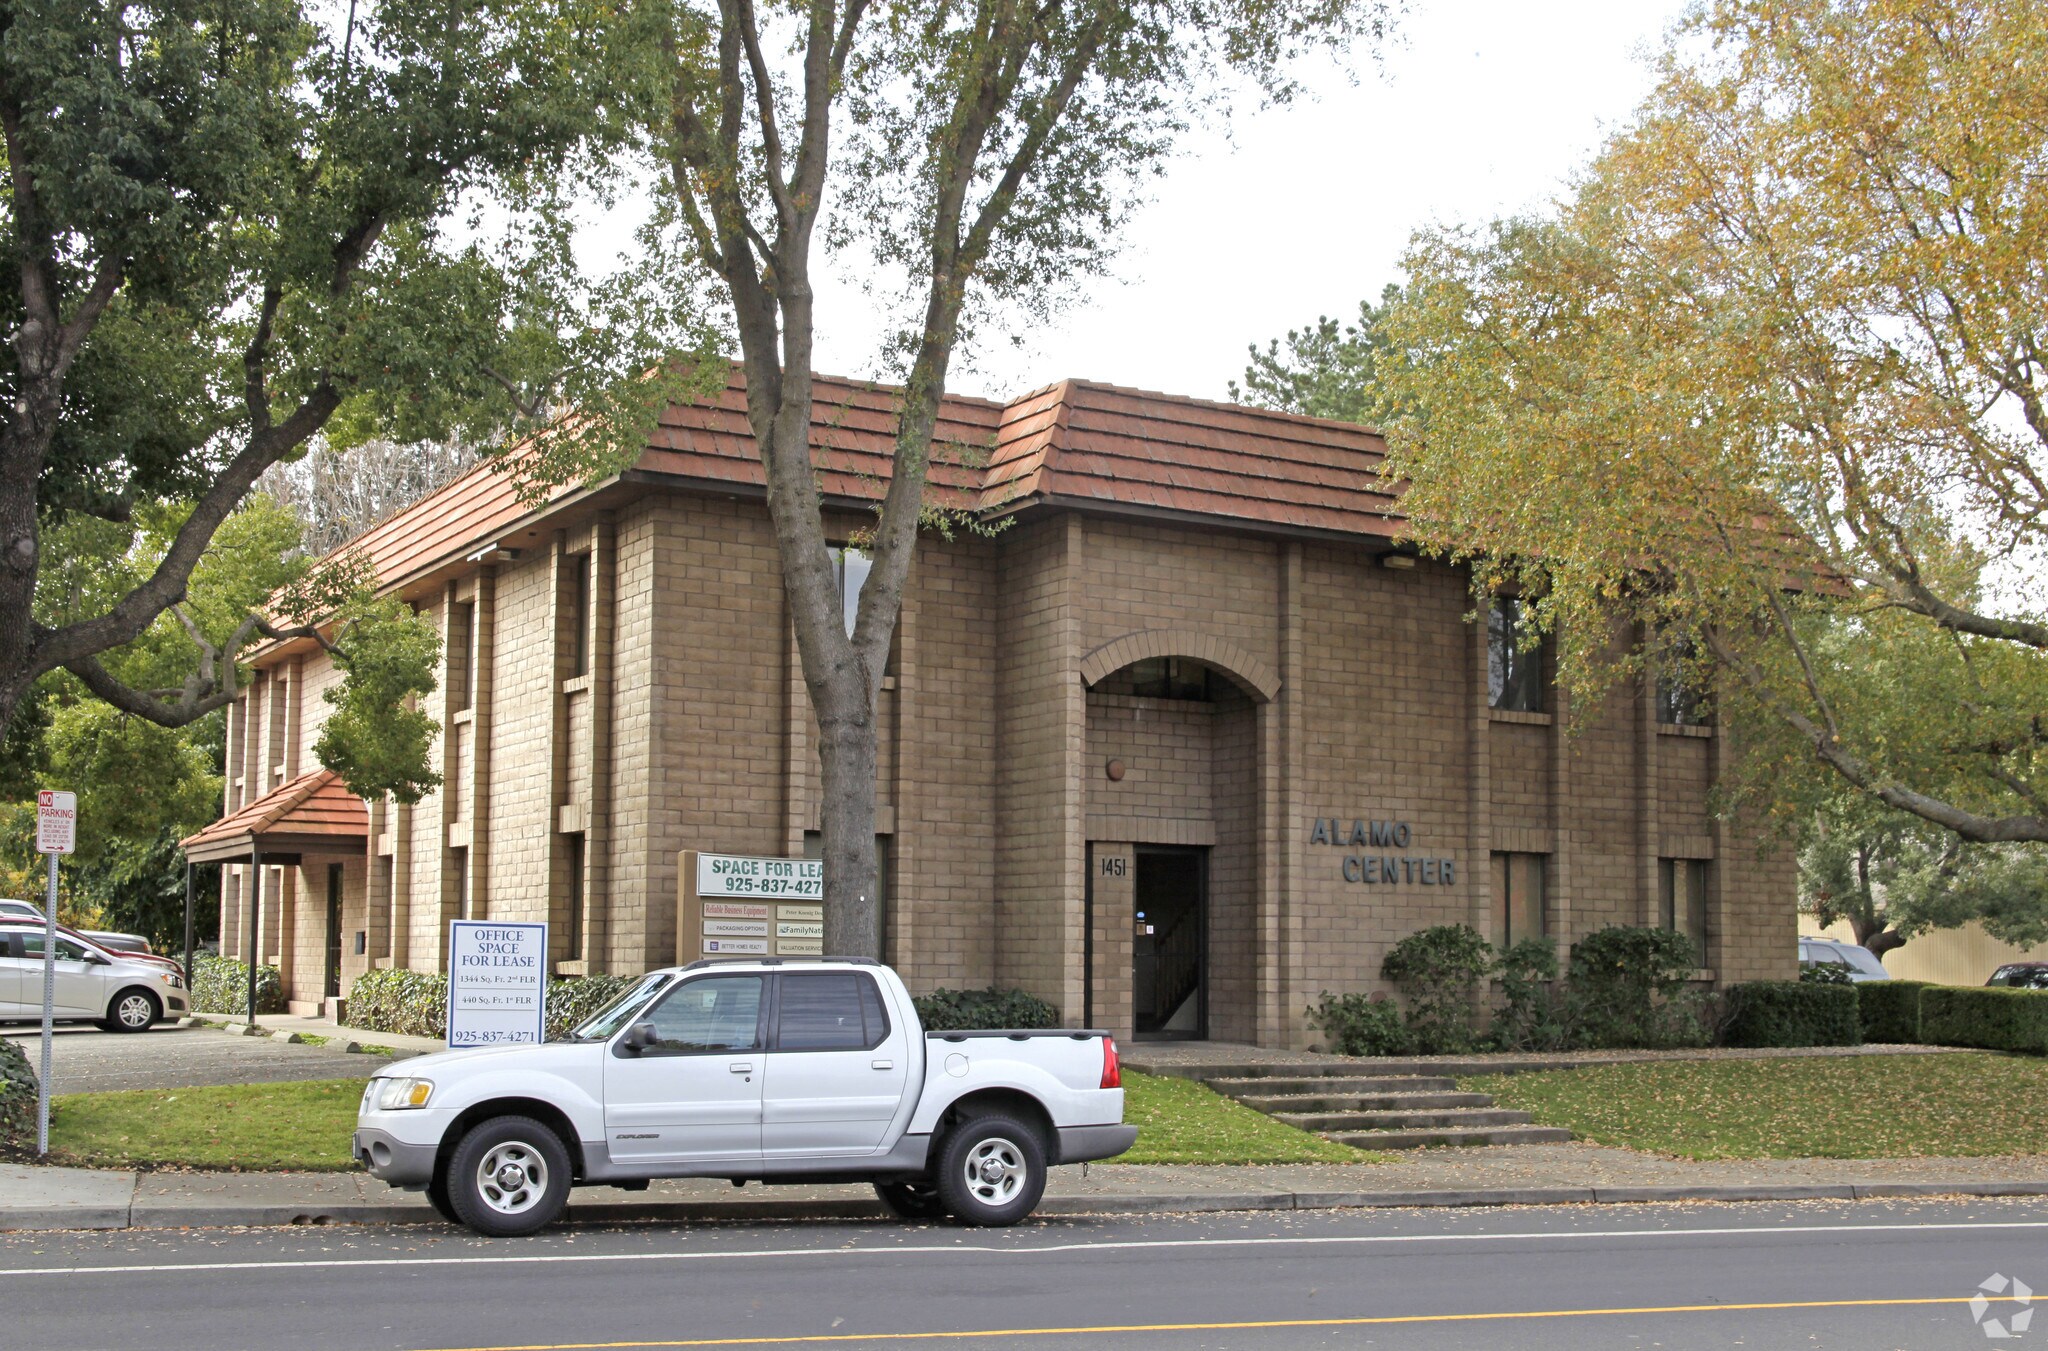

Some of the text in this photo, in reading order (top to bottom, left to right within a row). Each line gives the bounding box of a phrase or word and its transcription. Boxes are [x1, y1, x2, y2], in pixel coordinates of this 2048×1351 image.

[41, 793, 53, 805] NO
[41, 808, 73, 819] PARKING
[1310, 817, 1411, 848] ALAMO
[712, 859, 823, 878] SPACE FOR LEA
[1102, 858, 1126, 876] 1451
[1343, 855, 1456, 885] CENTER
[725, 877, 823, 894] 925-837-427
[724, 905, 742, 914] Business
[743, 905, 767, 917] Equipment
[474, 929, 524, 941] OFFICE
[478, 942, 519, 954] SPACE
[462, 955, 535, 967] FOR LEASE
[460, 975, 478, 983] 1344
[462, 996, 476, 1004] 440
[515, 996, 531, 1004] FLR
[455, 1030, 534, 1043] 925-837-4271
